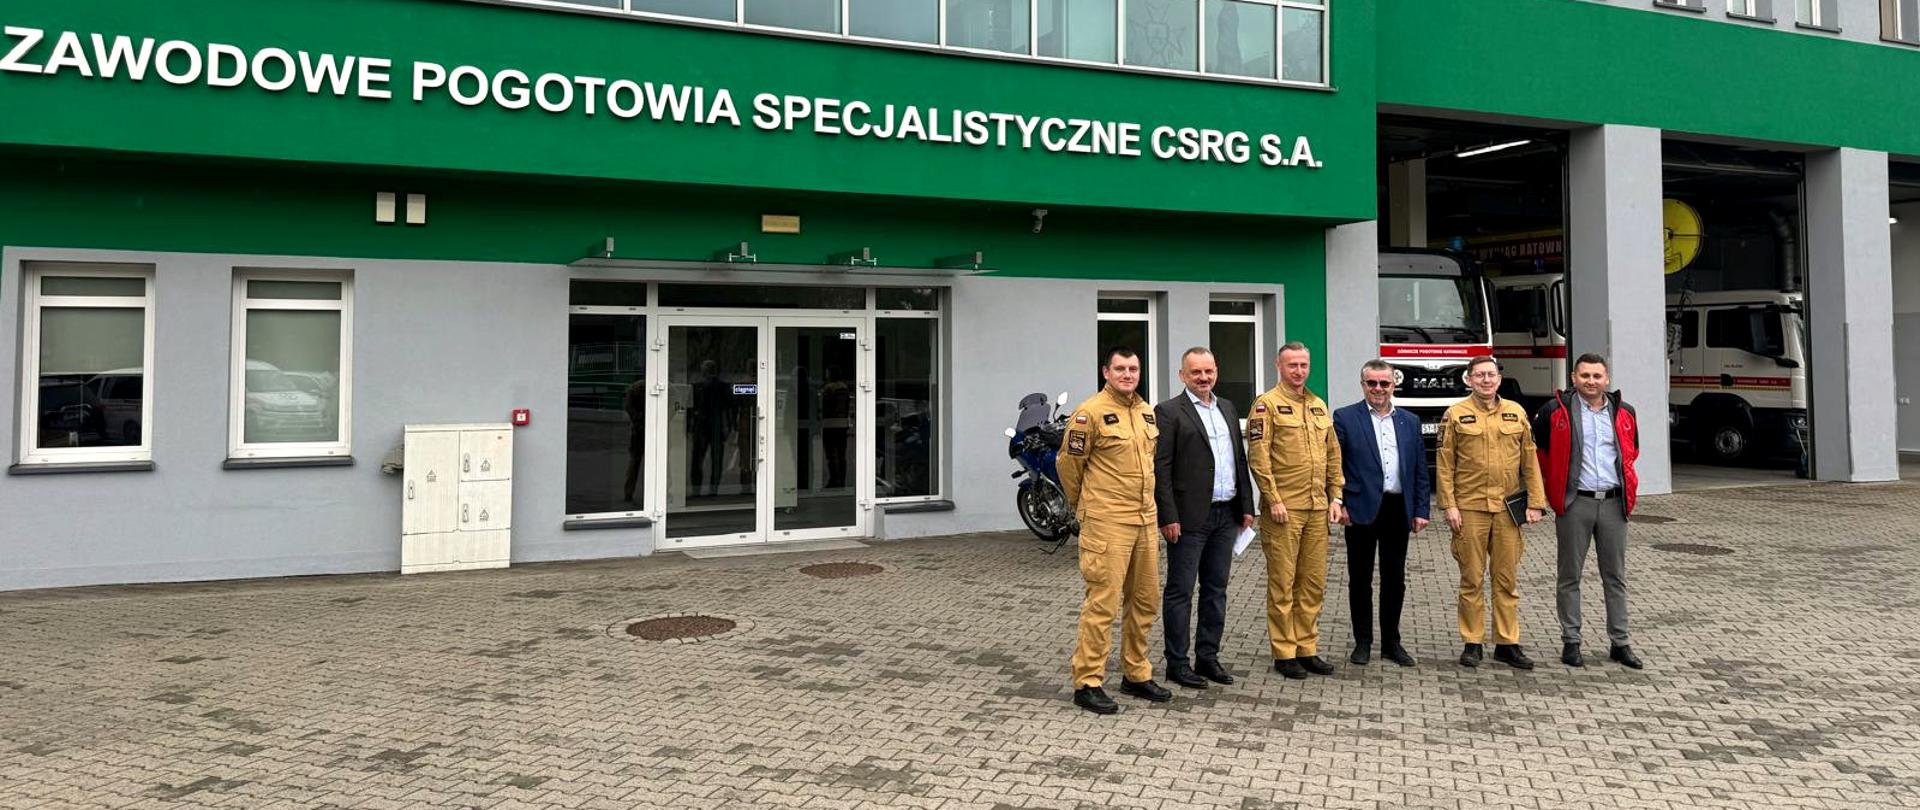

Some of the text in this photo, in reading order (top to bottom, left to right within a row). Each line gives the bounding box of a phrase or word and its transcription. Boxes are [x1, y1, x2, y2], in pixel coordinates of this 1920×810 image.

[0, 26, 1323, 168] ZAWODOWE POGOTOWIA SPECJALISTYCZNE CSRG S.A.
[1412, 377, 1454, 389] MAN
